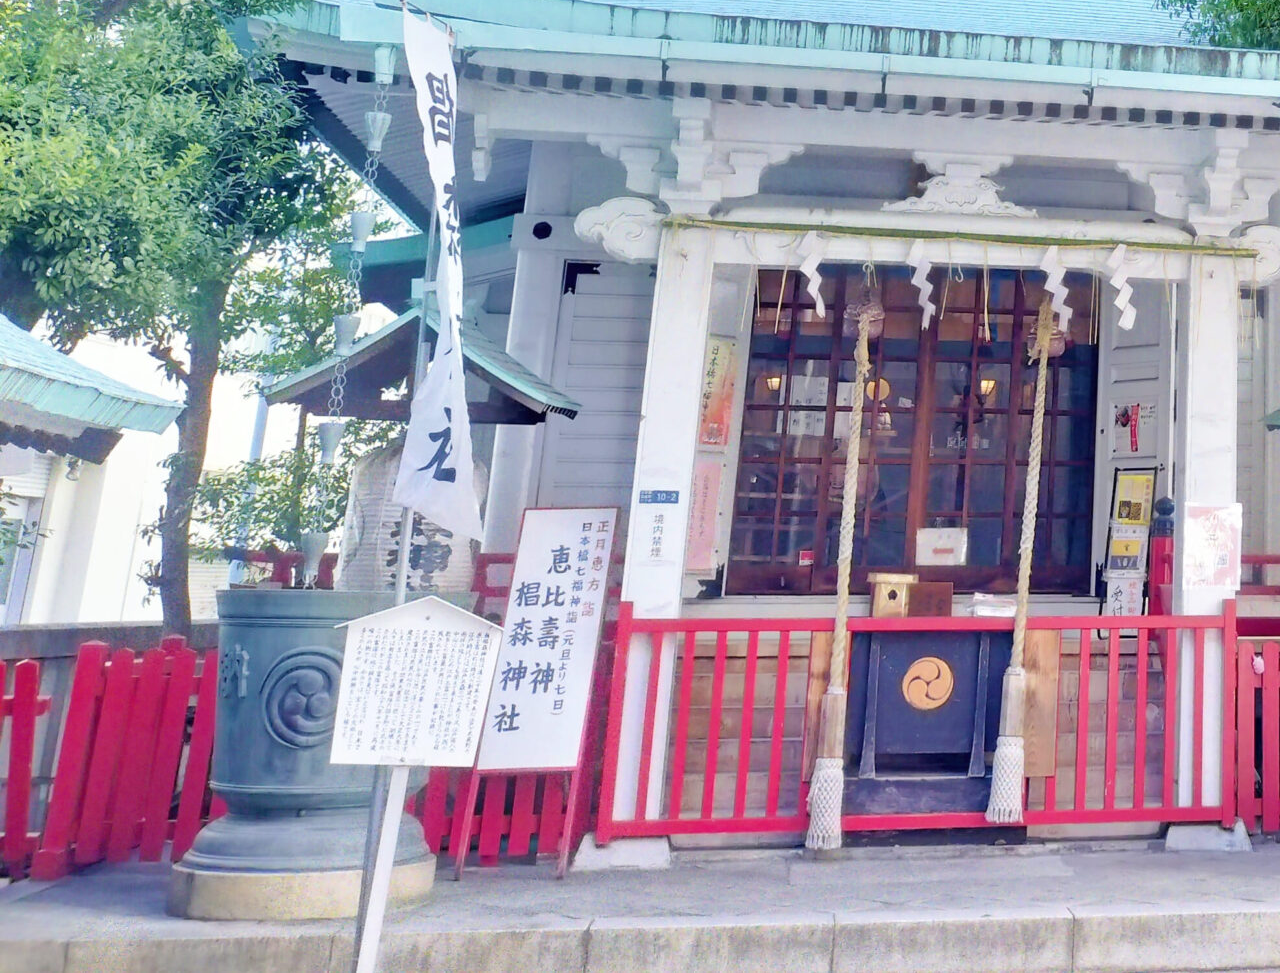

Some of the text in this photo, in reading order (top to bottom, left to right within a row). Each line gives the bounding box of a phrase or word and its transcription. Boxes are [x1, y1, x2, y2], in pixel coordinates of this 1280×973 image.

[656, 493, 677, 502] 10-2
[530, 544, 572, 695] 恵比壽神
[580, 520, 610, 618] 正月恵方詣
[491, 580, 542, 734] 椙森神社
